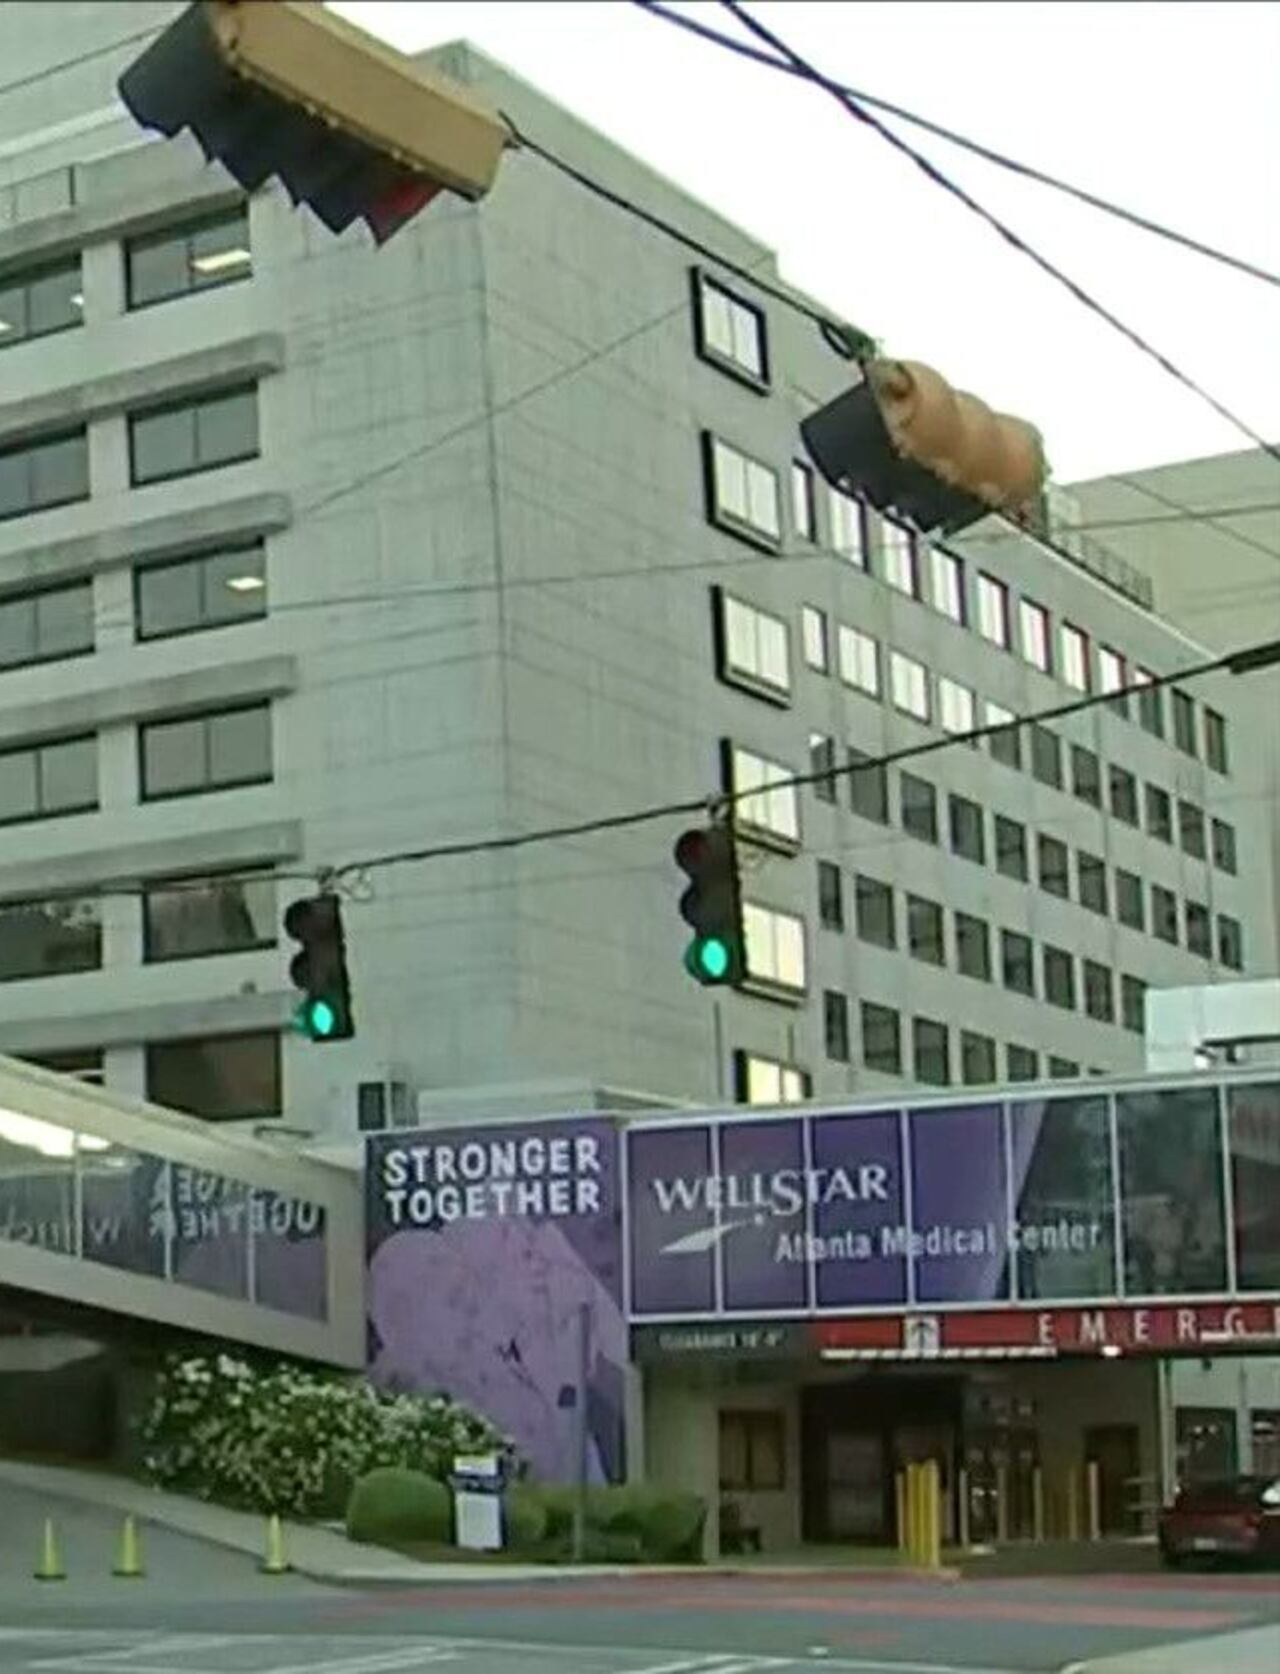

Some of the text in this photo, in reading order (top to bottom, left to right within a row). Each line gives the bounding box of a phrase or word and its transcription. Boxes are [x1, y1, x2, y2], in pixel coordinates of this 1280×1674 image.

[383, 1136, 601, 1187] STRONGER
[384, 1179, 600, 1224] TOGETHER
[773, 1229, 872, 1263] Atlanta
[880, 1222, 996, 1257] Medical
